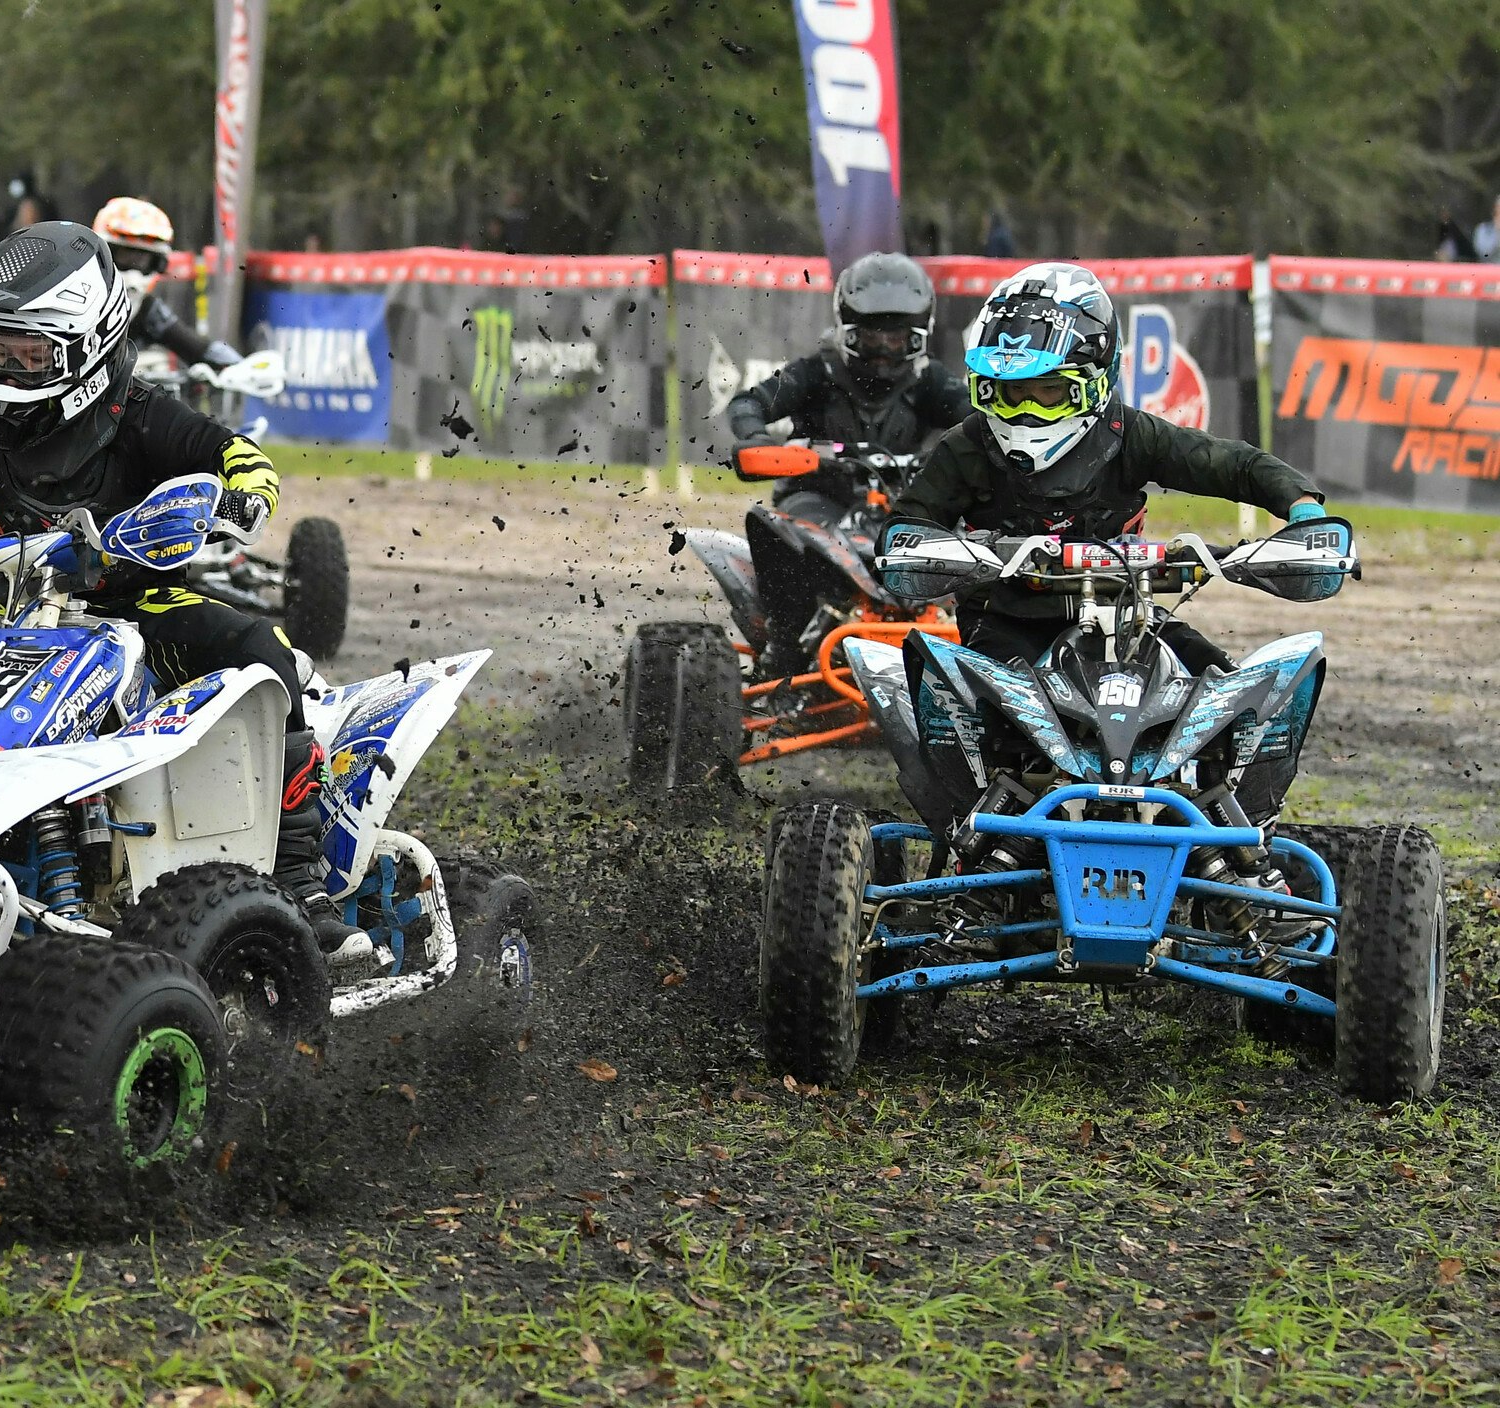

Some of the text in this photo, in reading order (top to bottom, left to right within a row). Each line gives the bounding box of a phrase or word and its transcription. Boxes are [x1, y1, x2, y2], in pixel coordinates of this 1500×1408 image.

[160, 541, 194, 558] CYCRA
[1305, 530, 1341, 551] 150
[52, 650, 79, 677] KENDA
[1098, 680, 1143, 707] 150
[125, 715, 189, 735] KENDA
